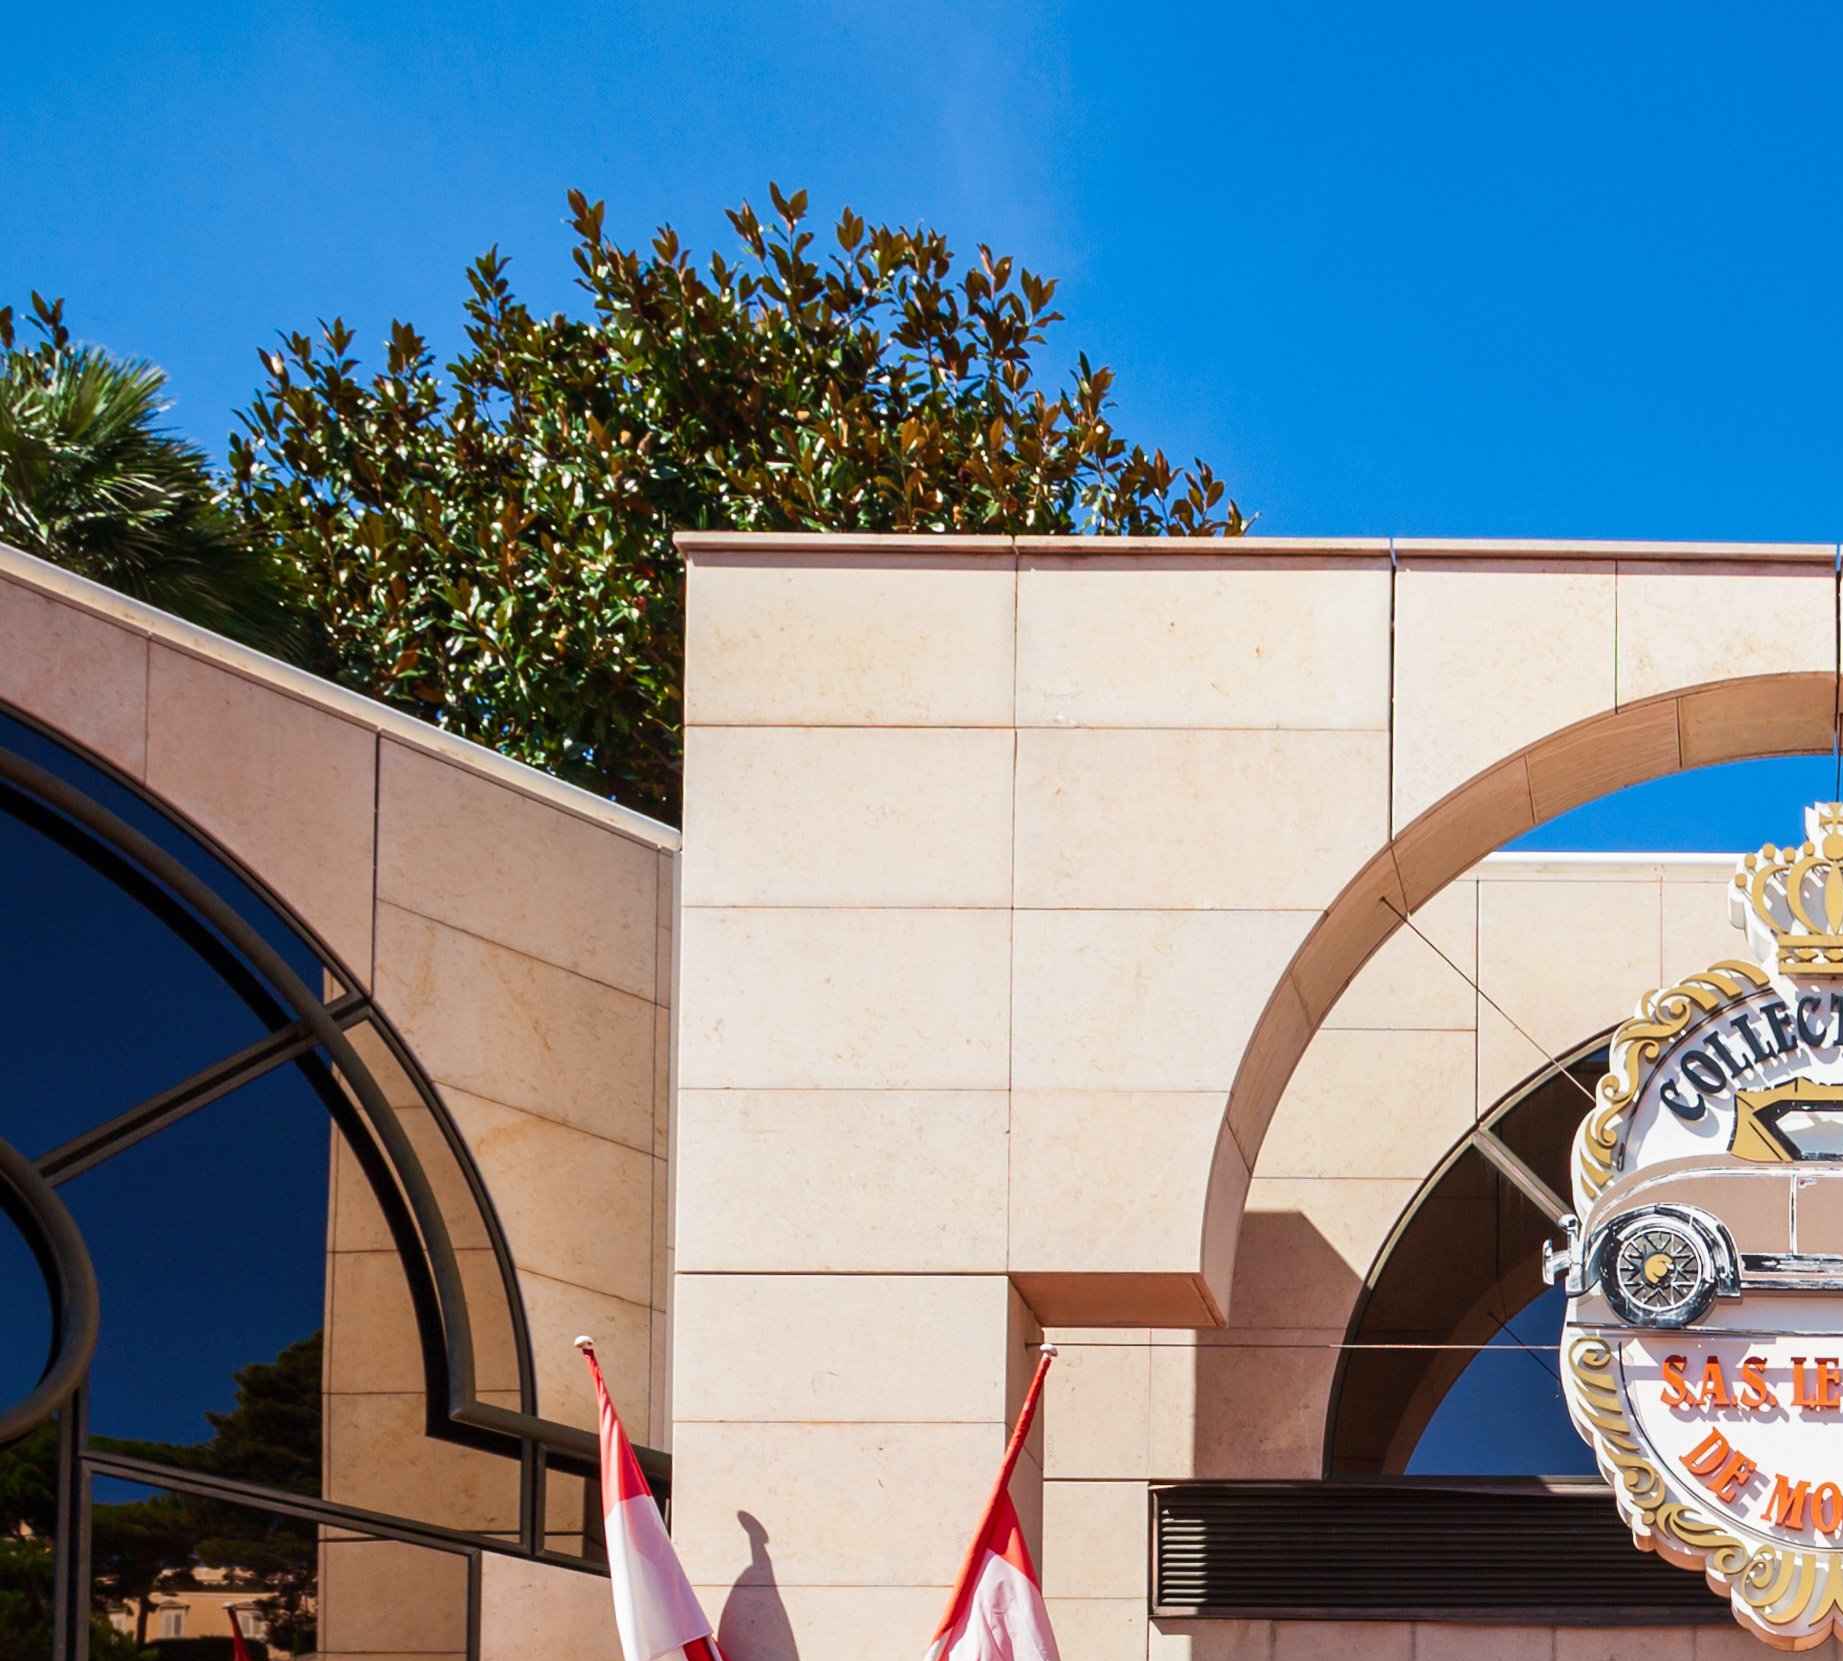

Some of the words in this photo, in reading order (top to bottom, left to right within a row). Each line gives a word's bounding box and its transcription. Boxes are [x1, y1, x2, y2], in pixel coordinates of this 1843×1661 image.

[1660, 1354, 1777, 1408] S.A.S.
[1790, 1356, 1841, 1408] LE
[1678, 1426, 1757, 1502] DE
